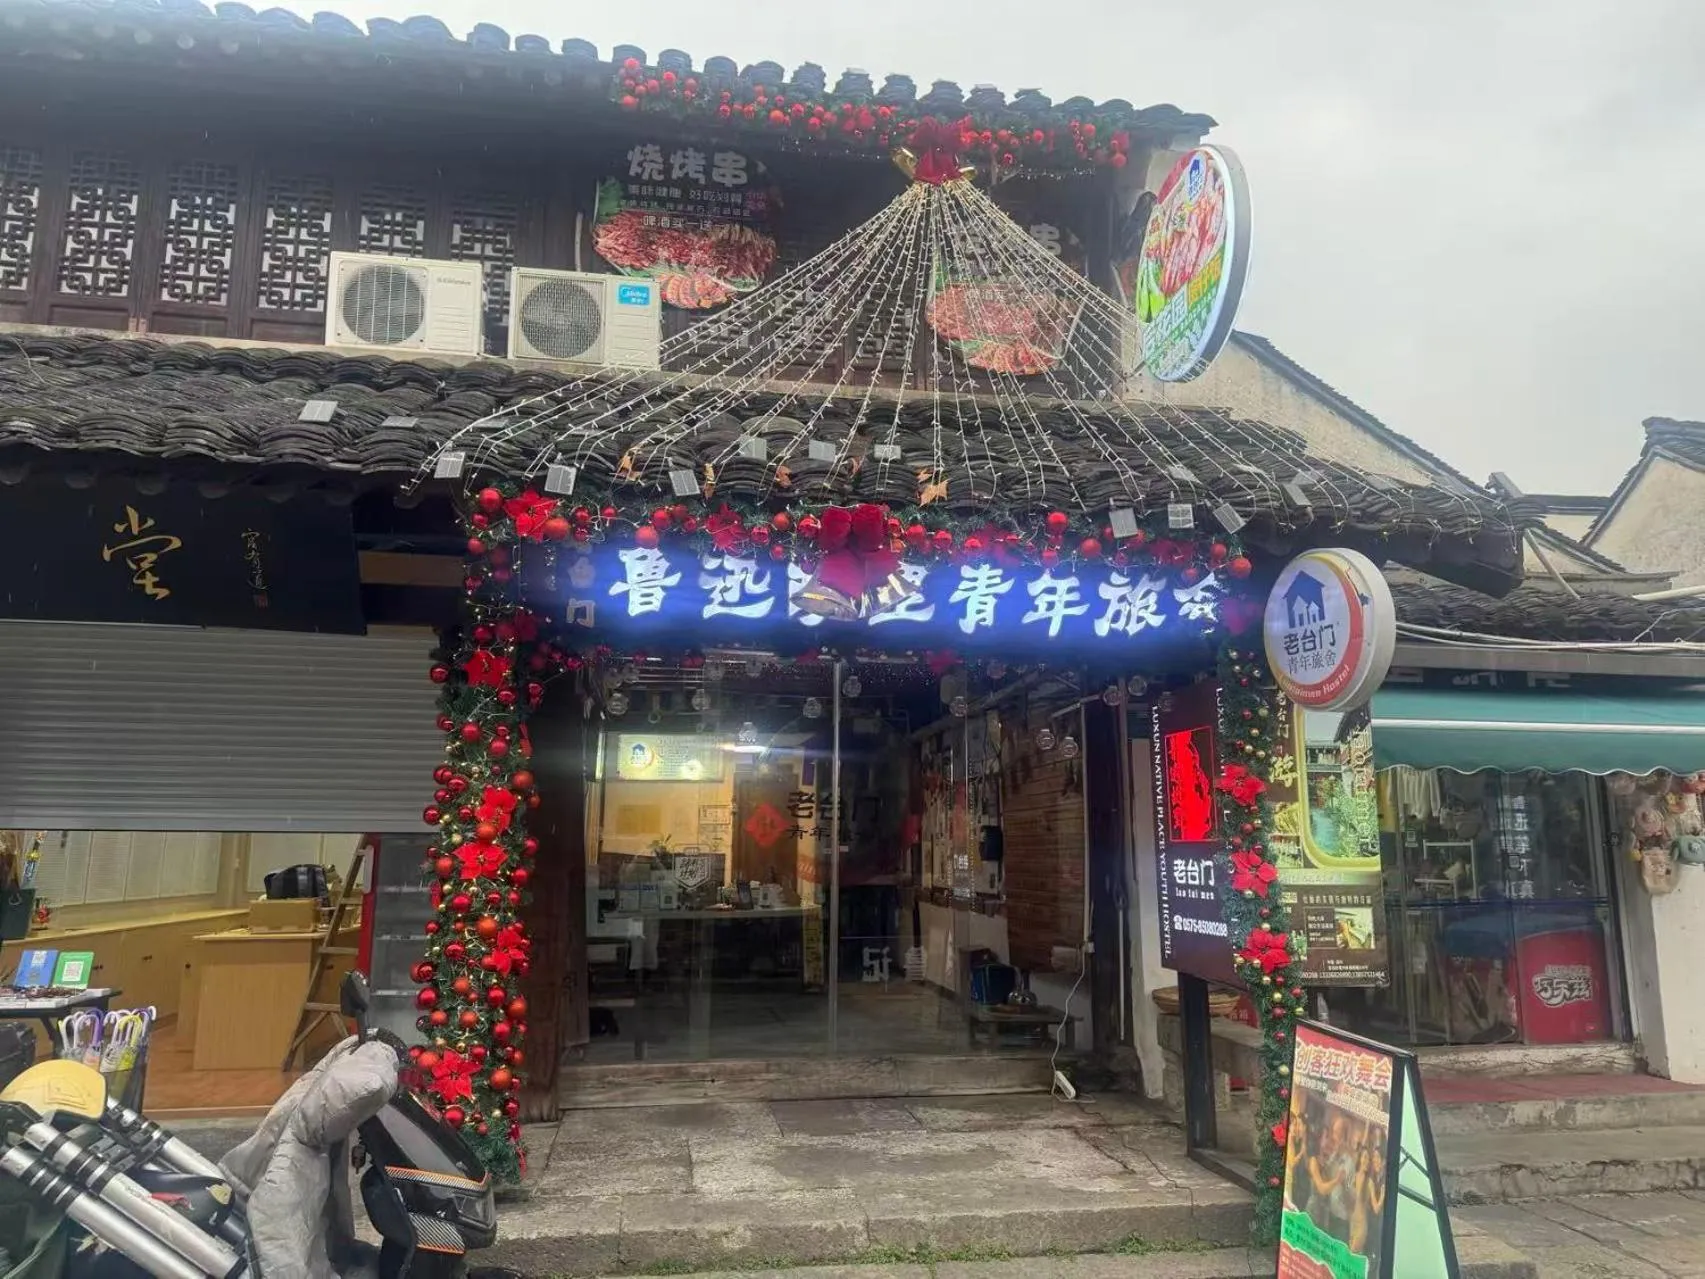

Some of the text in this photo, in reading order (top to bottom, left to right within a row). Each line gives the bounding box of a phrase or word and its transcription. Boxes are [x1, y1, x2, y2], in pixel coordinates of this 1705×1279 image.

[627, 144, 748, 187] 烧烤串
[1284, 624, 1336, 656] 老台门
[1288, 651, 1337, 674] 青年旅舍
[1152, 705, 1161, 752] LUXUN
[1173, 858, 1215, 886] 老台门
